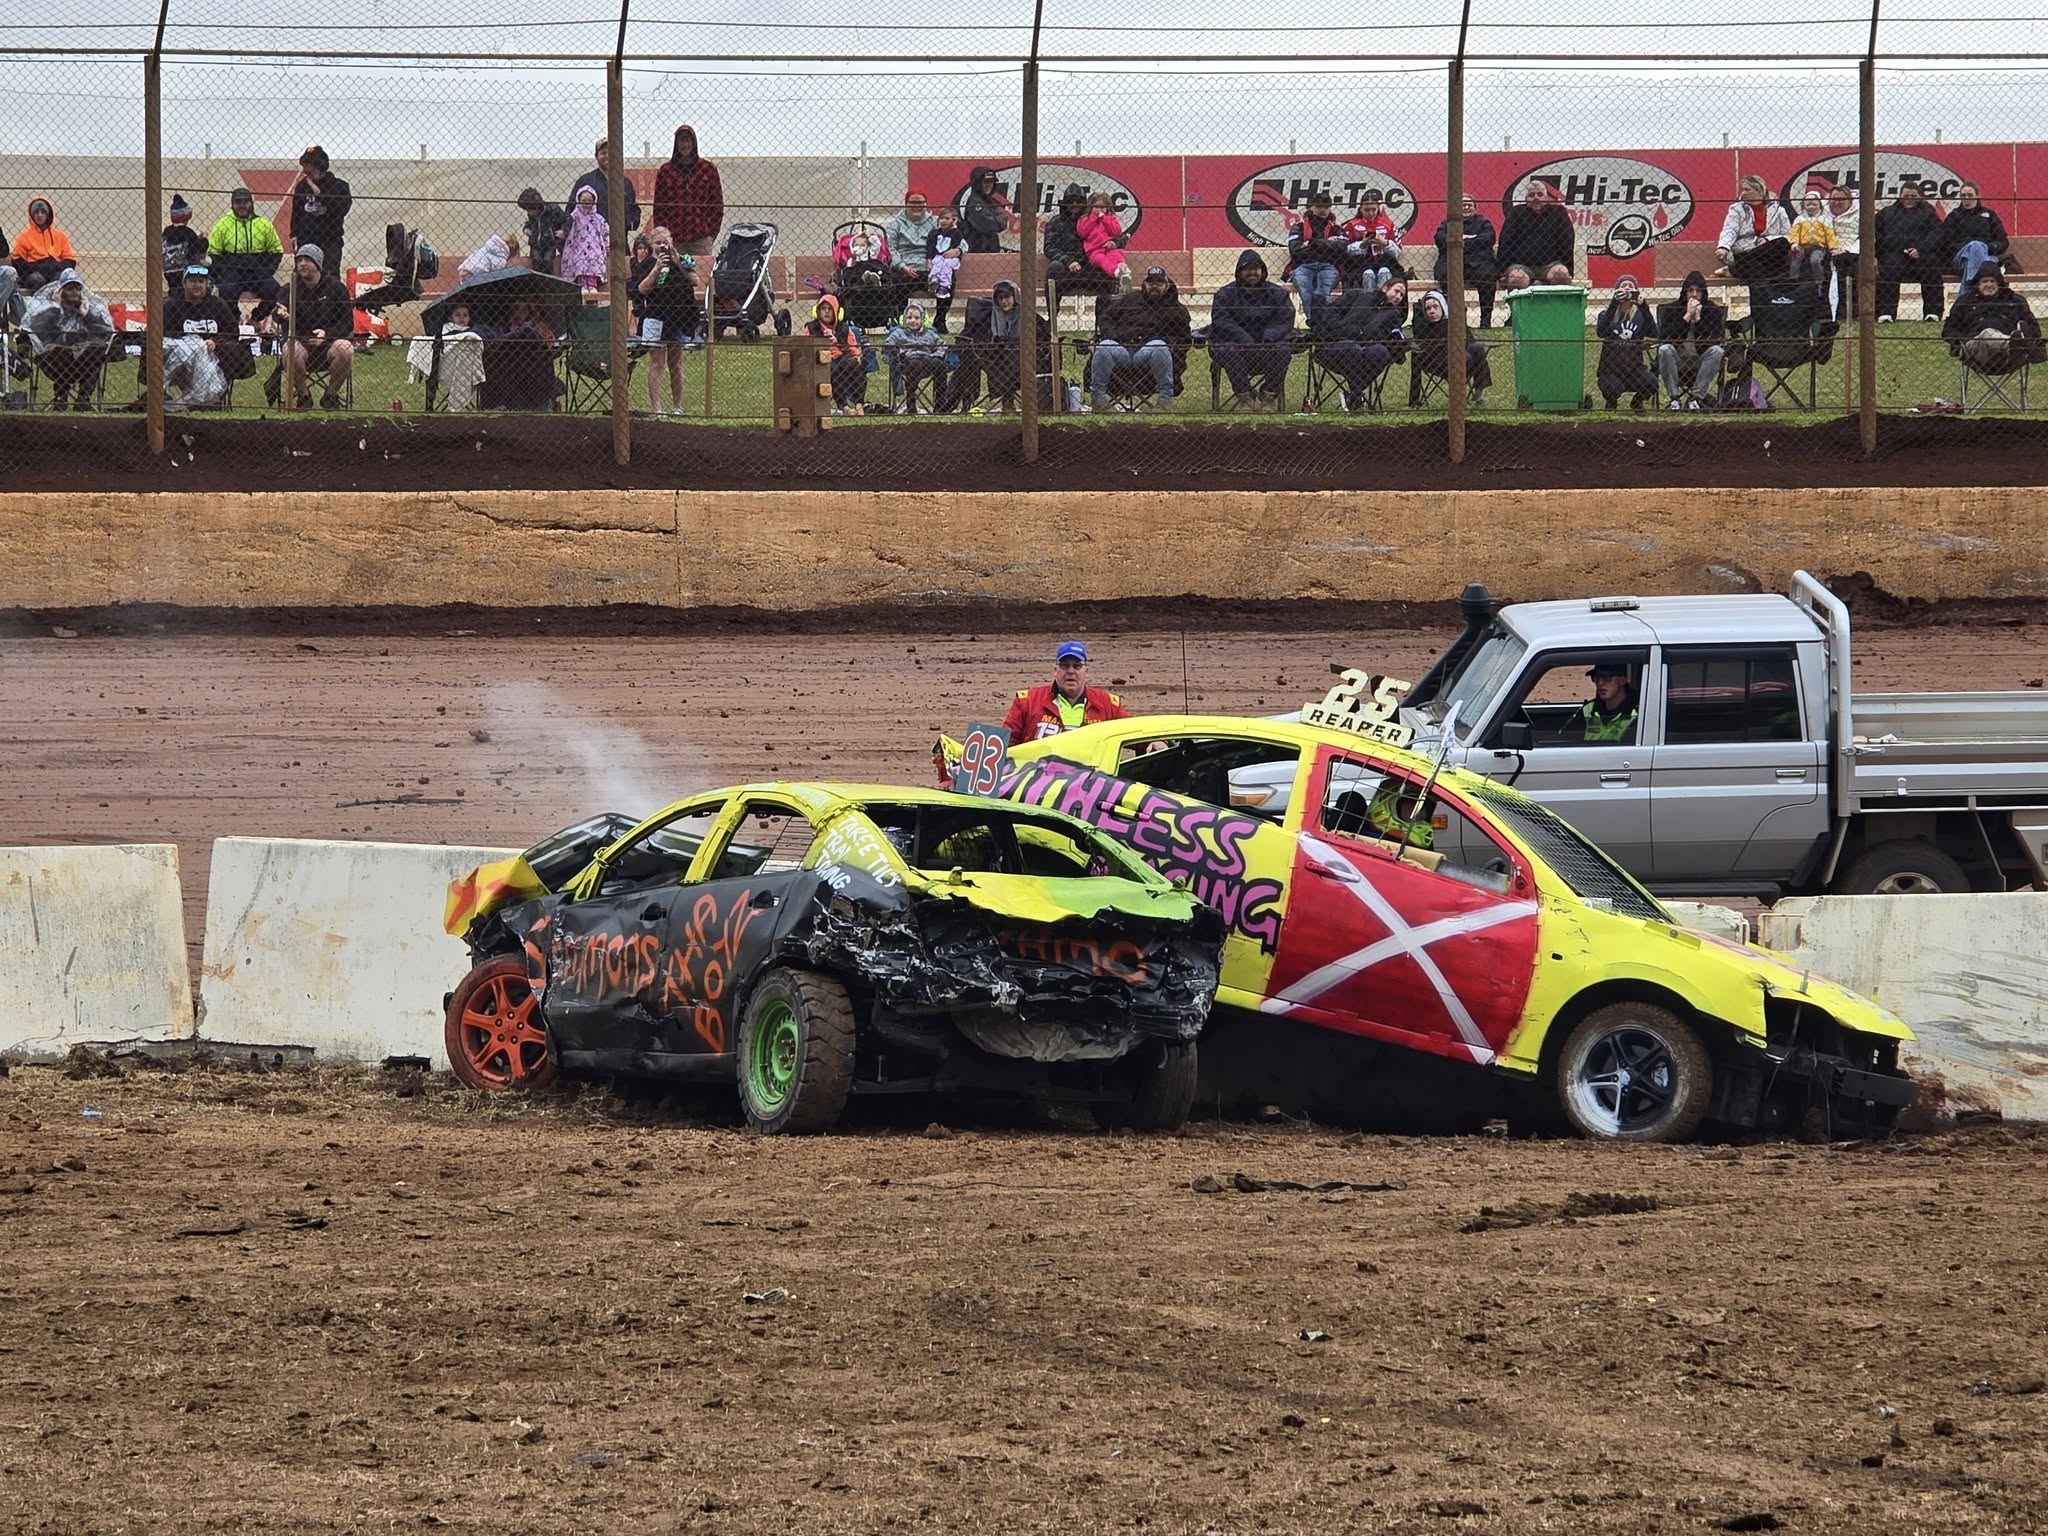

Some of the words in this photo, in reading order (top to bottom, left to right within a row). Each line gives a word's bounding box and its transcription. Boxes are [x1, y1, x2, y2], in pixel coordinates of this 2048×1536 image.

[1565, 174, 1682, 206] Hi-Tec
[1320, 667, 1412, 720] 25
[1309, 708, 1403, 742] REAPER
[961, 730, 1005, 796] 93
